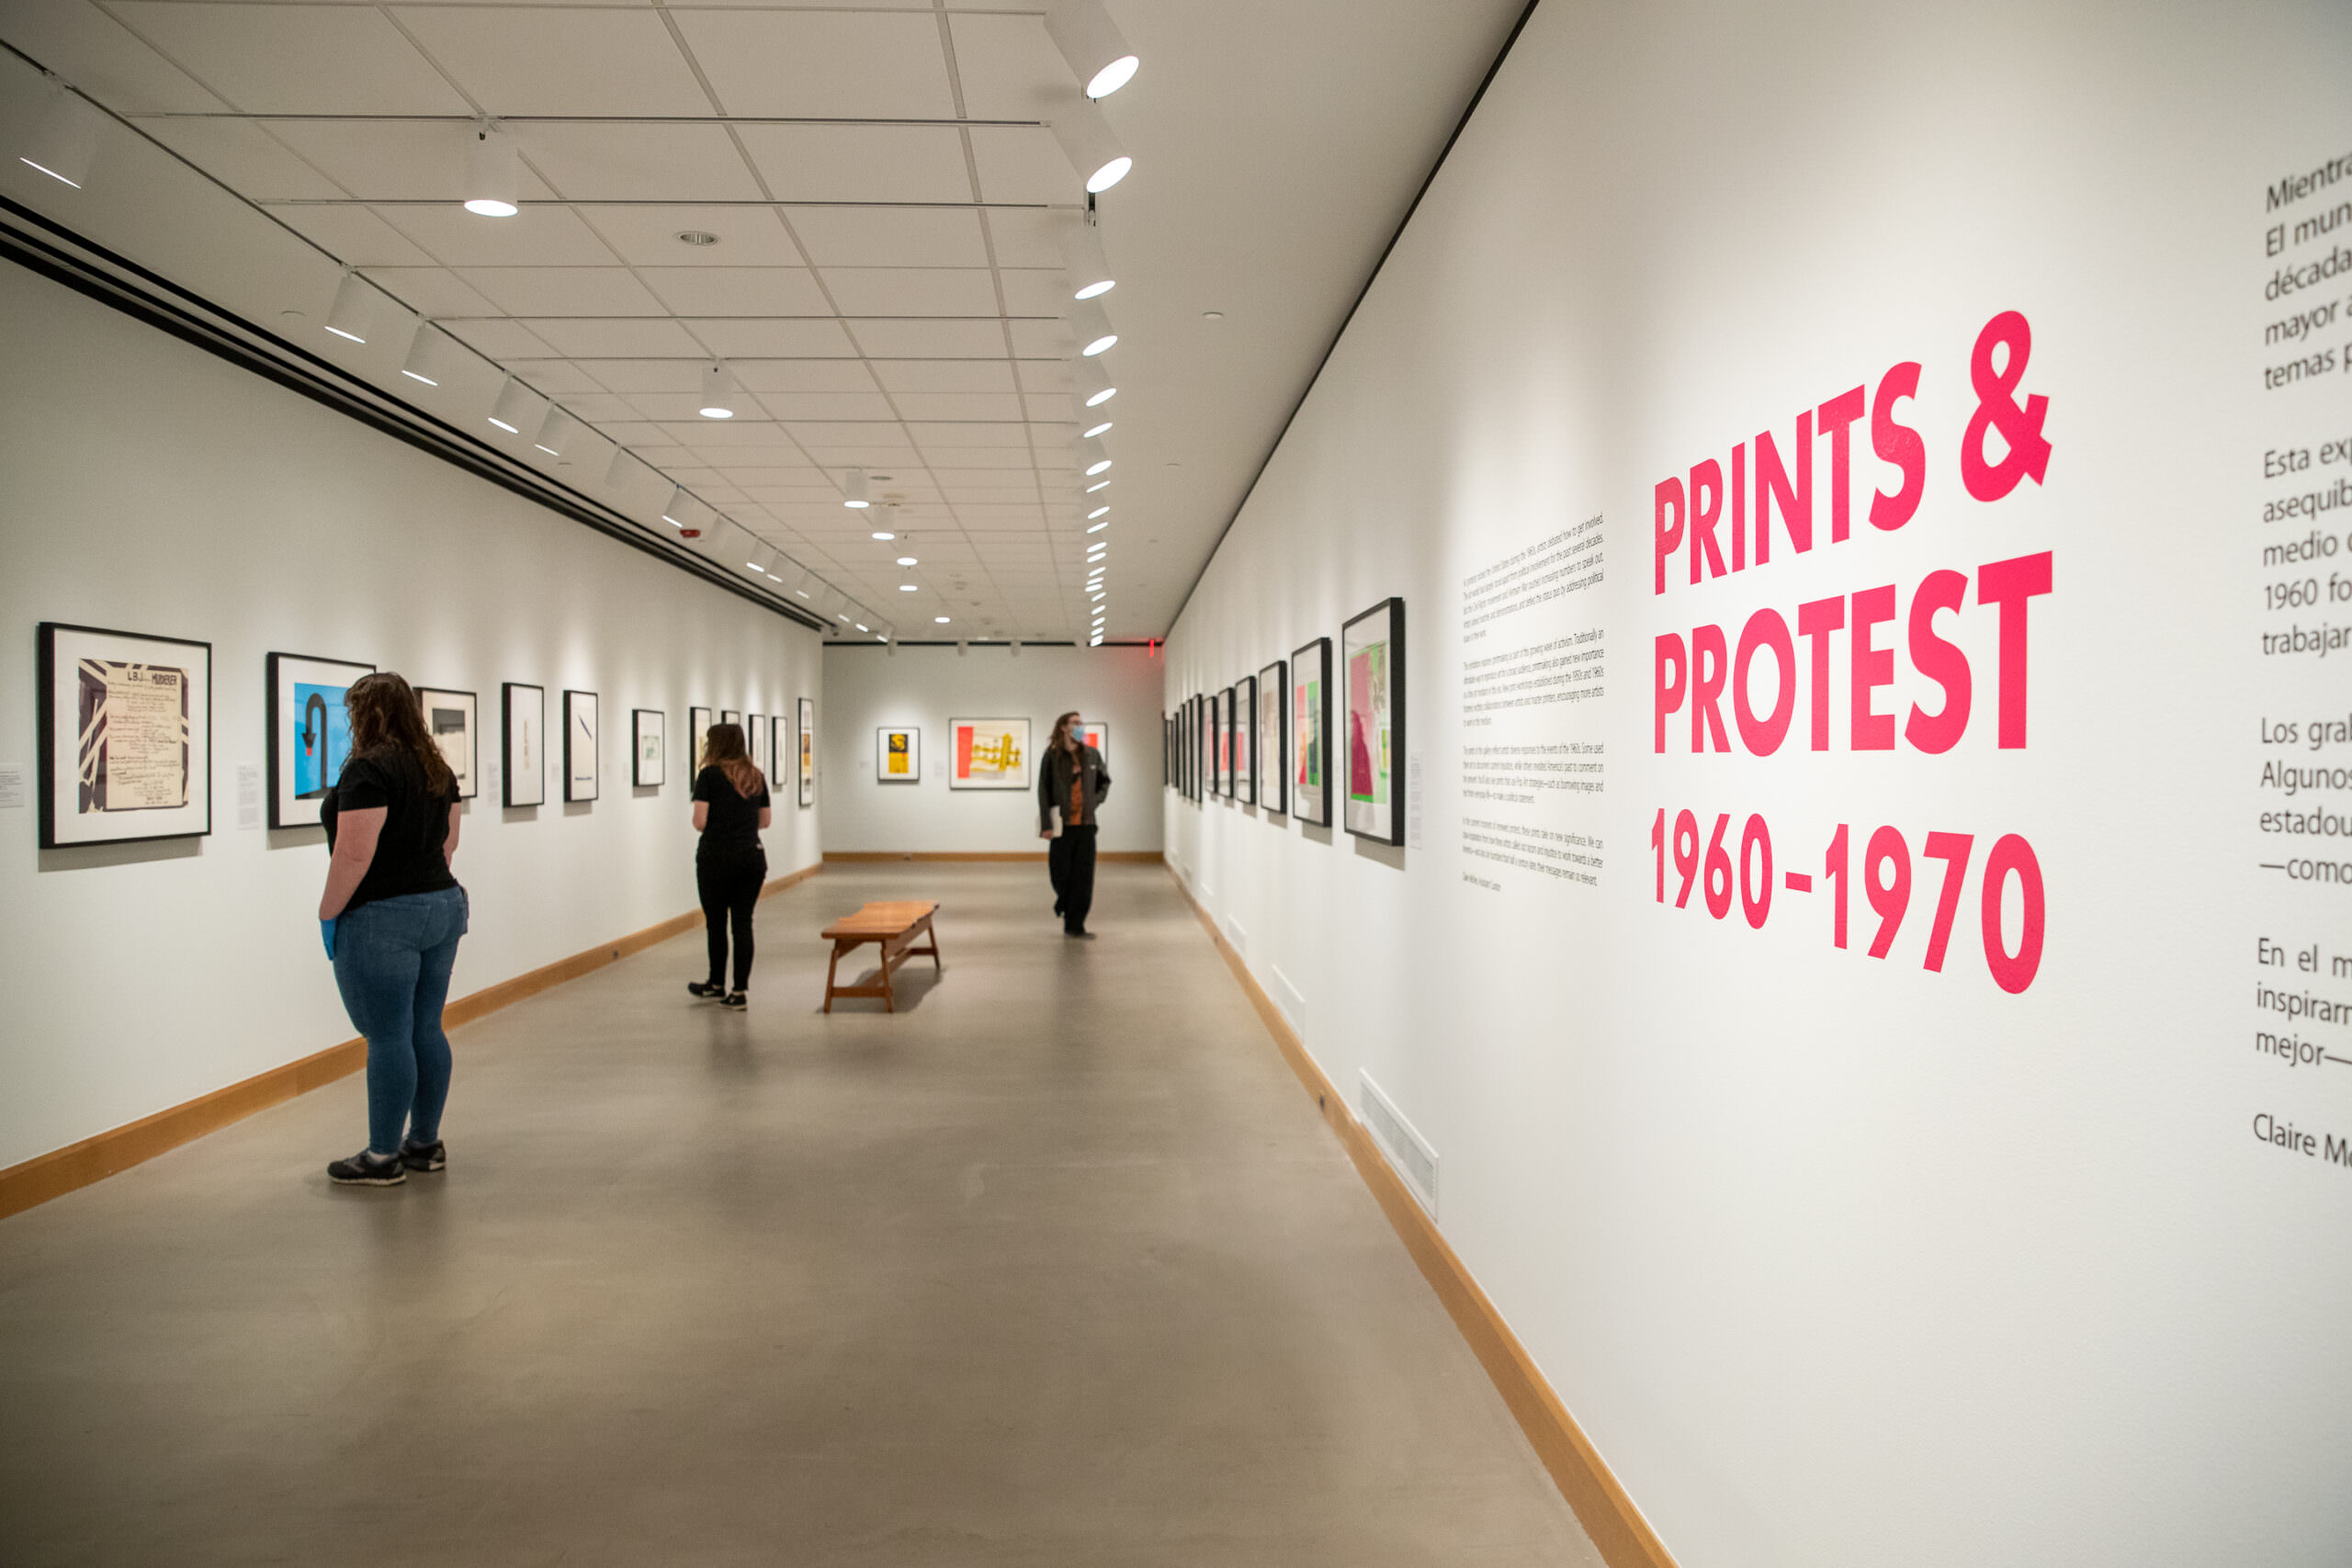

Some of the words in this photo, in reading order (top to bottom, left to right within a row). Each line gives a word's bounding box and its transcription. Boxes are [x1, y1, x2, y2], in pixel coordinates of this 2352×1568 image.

[2265, 223, 2285, 258] El
[2294, 200, 2352, 246] mun
[2264, 245, 2352, 302] década
[2264, 299, 2340, 347] mayor
[2263, 348, 2335, 391] temas
[1654, 360, 1927, 596] PRINTS
[1960, 310, 2052, 502] &
[2263, 448, 2311, 479] Esta
[2319, 437, 2352, 468] ex
[2262, 529, 2339, 568] medio
[2263, 578, 2320, 611] 1960
[2328, 571, 2352, 604] fo
[1654, 550, 2053, 758] PROTEST
[2261, 622, 2352, 660] trabajar
[2261, 716, 2299, 744] Los
[2307, 712, 2352, 751] gra
[2257, 937, 2286, 967] En
[2297, 943, 2319, 974] el
[2253, 1111, 2317, 1157] Claire
[2324, 1133, 2352, 1168] M
